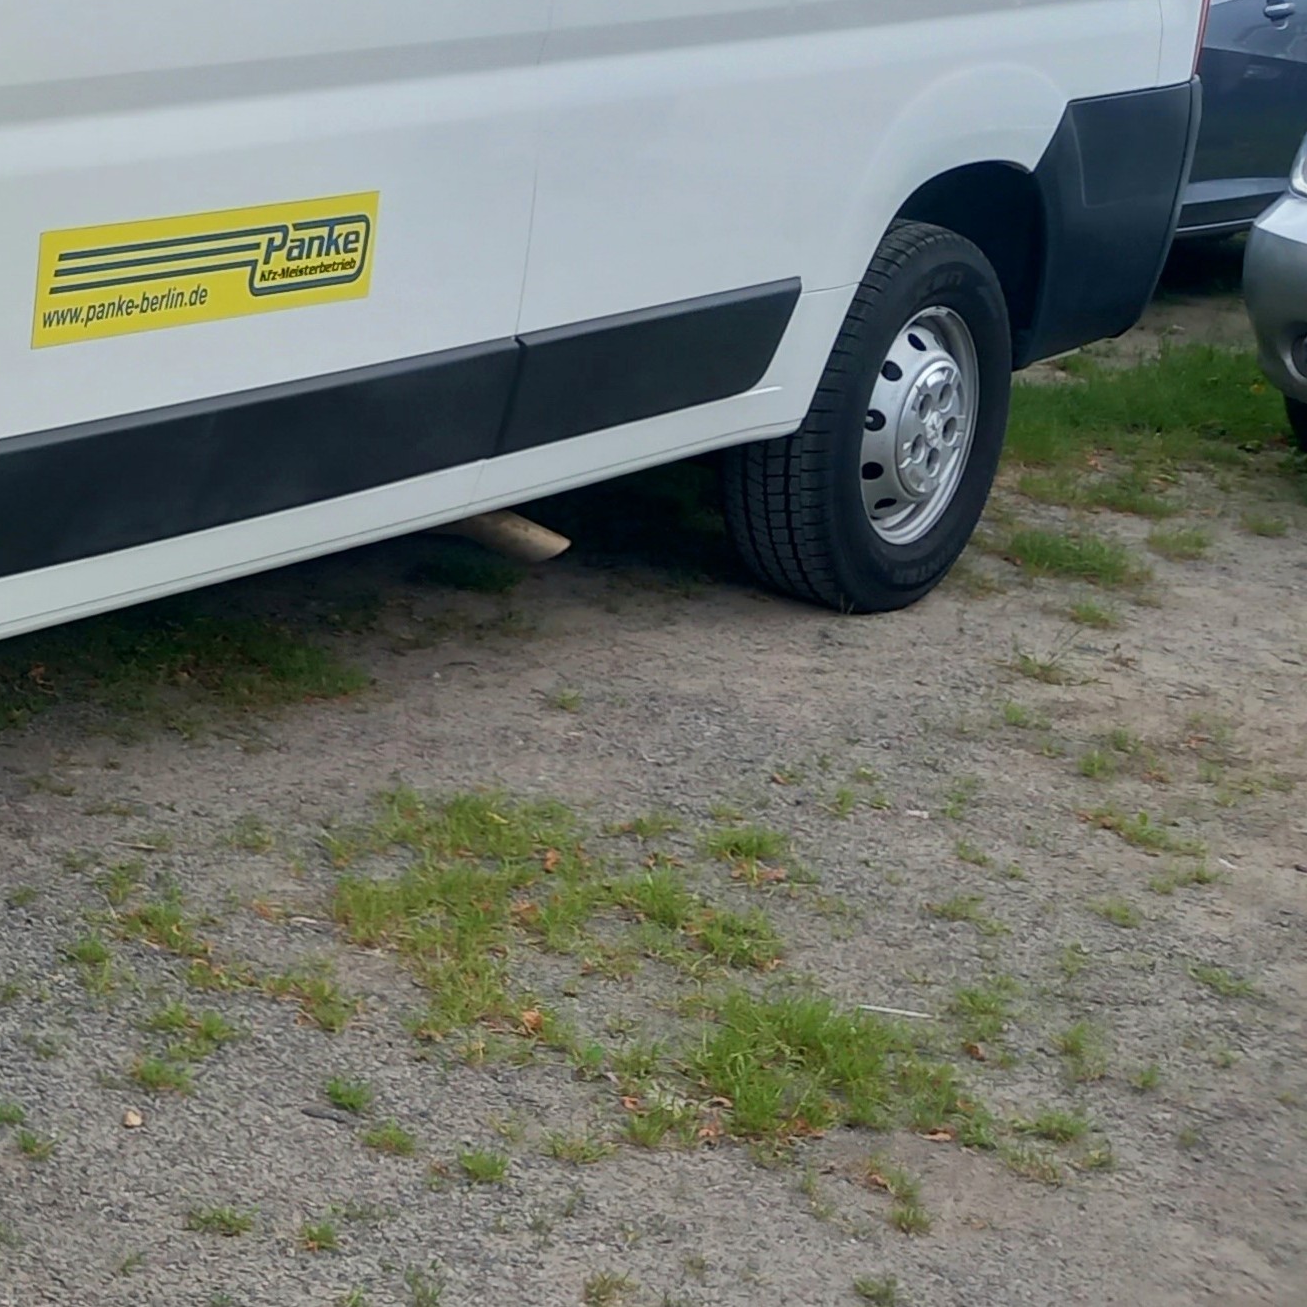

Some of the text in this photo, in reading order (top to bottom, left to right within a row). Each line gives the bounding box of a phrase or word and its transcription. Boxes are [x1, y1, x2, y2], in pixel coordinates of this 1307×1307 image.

[263, 224, 361, 266] Panke
[260, 257, 357, 282] Kfz-Meisterbetrieb
[42, 283, 208, 328] www.panke-berlin.de
